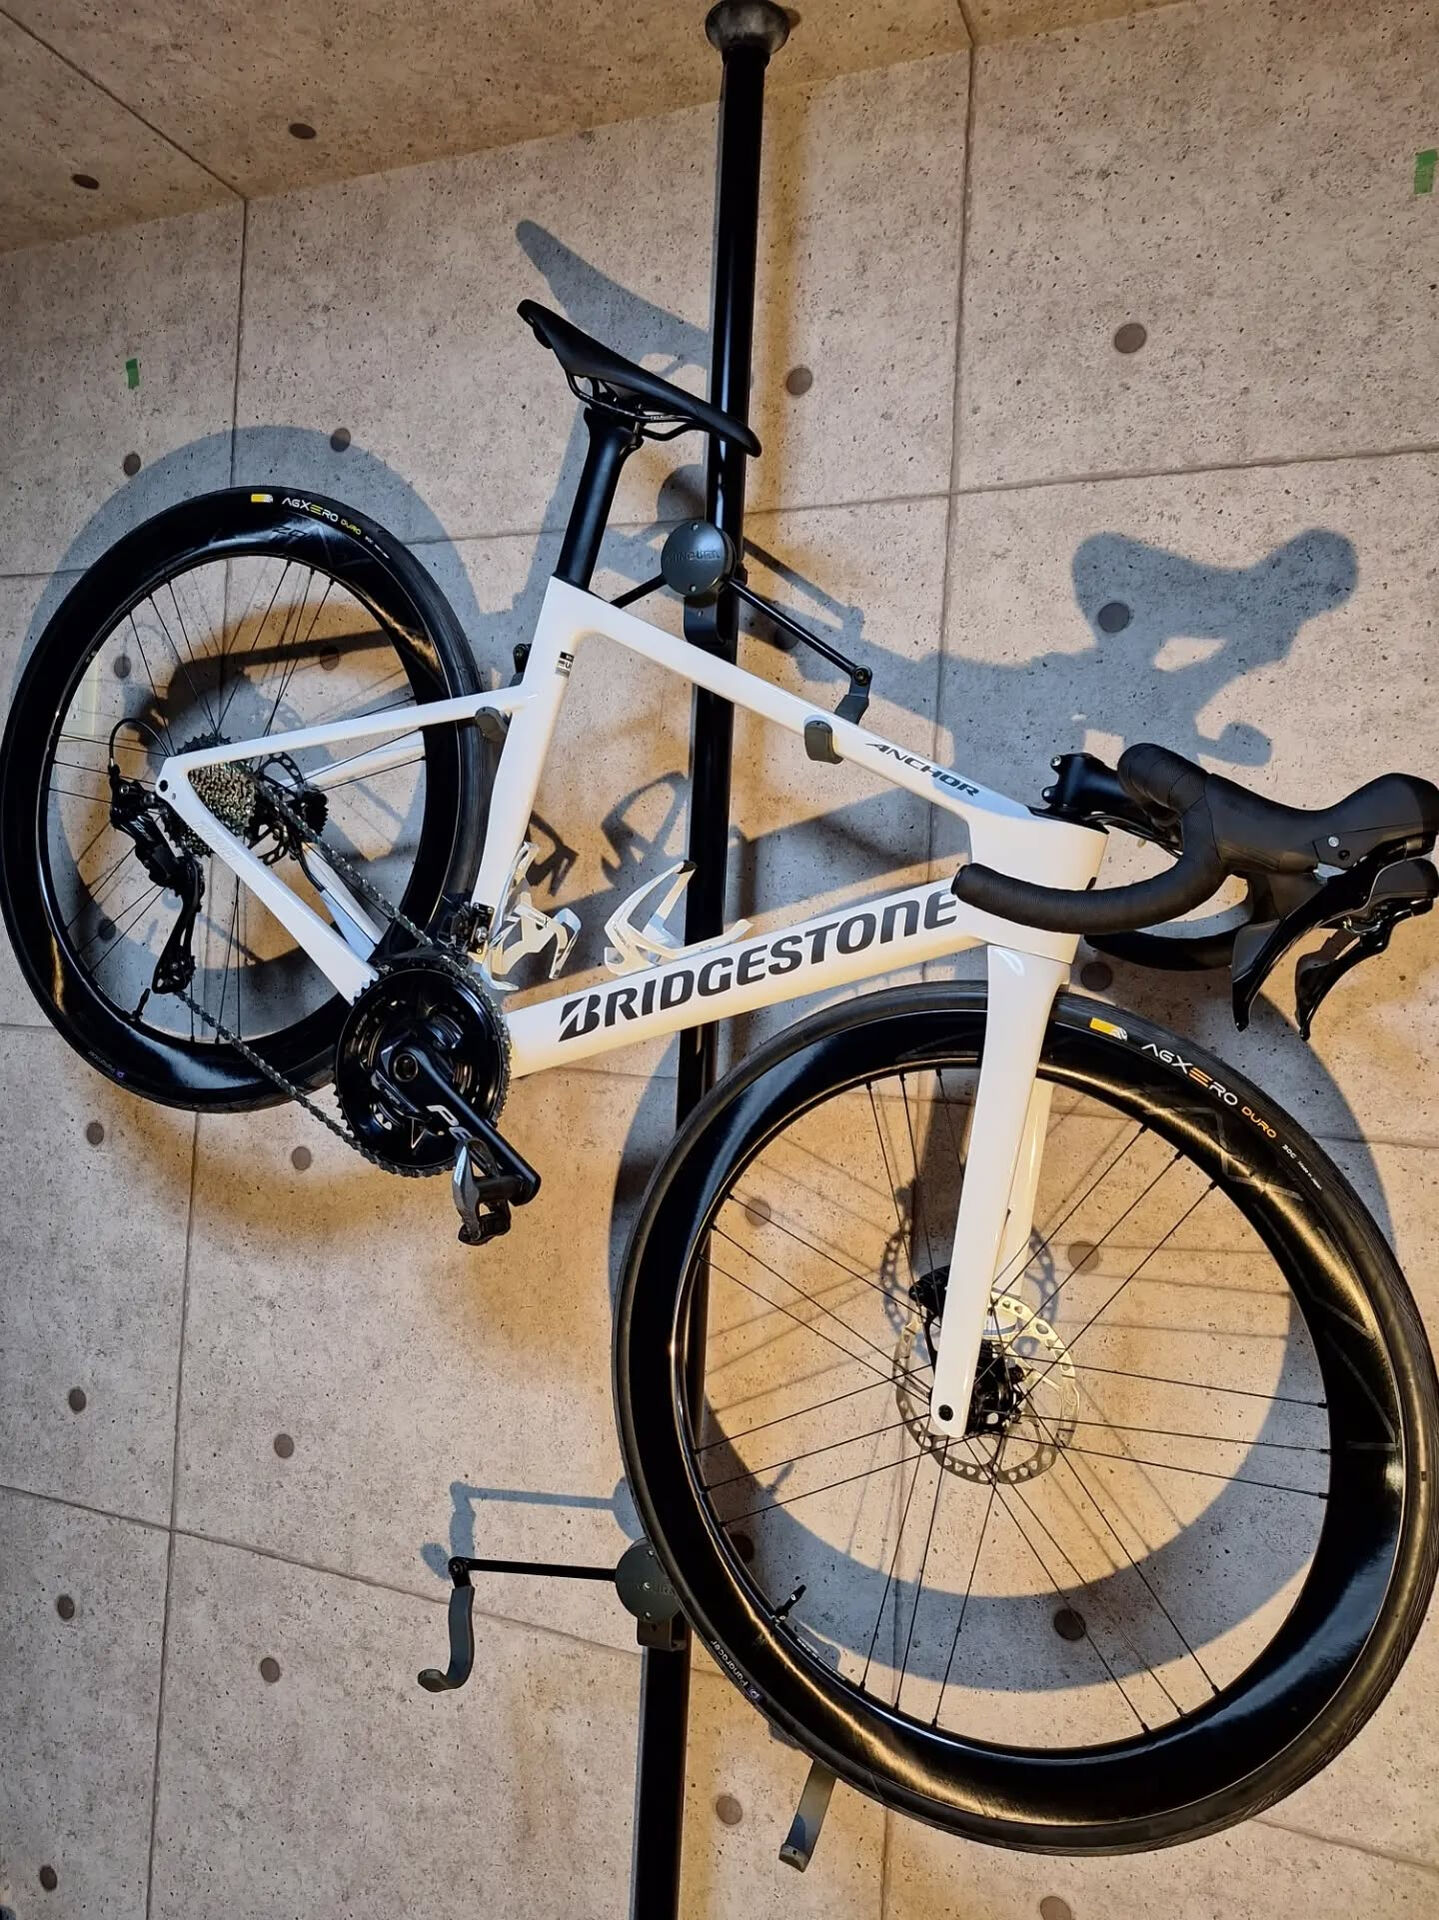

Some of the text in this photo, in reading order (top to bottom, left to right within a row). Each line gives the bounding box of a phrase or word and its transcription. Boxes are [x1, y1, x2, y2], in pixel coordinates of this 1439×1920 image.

[282, 497, 339, 523] AGXERO
[865, 743, 980, 797] ANCHOR
[558, 889, 959, 1042] BRIDGESTONE
[1141, 1043, 1238, 1106] AGXERO
[1241, 1105, 1277, 1139] DURO
